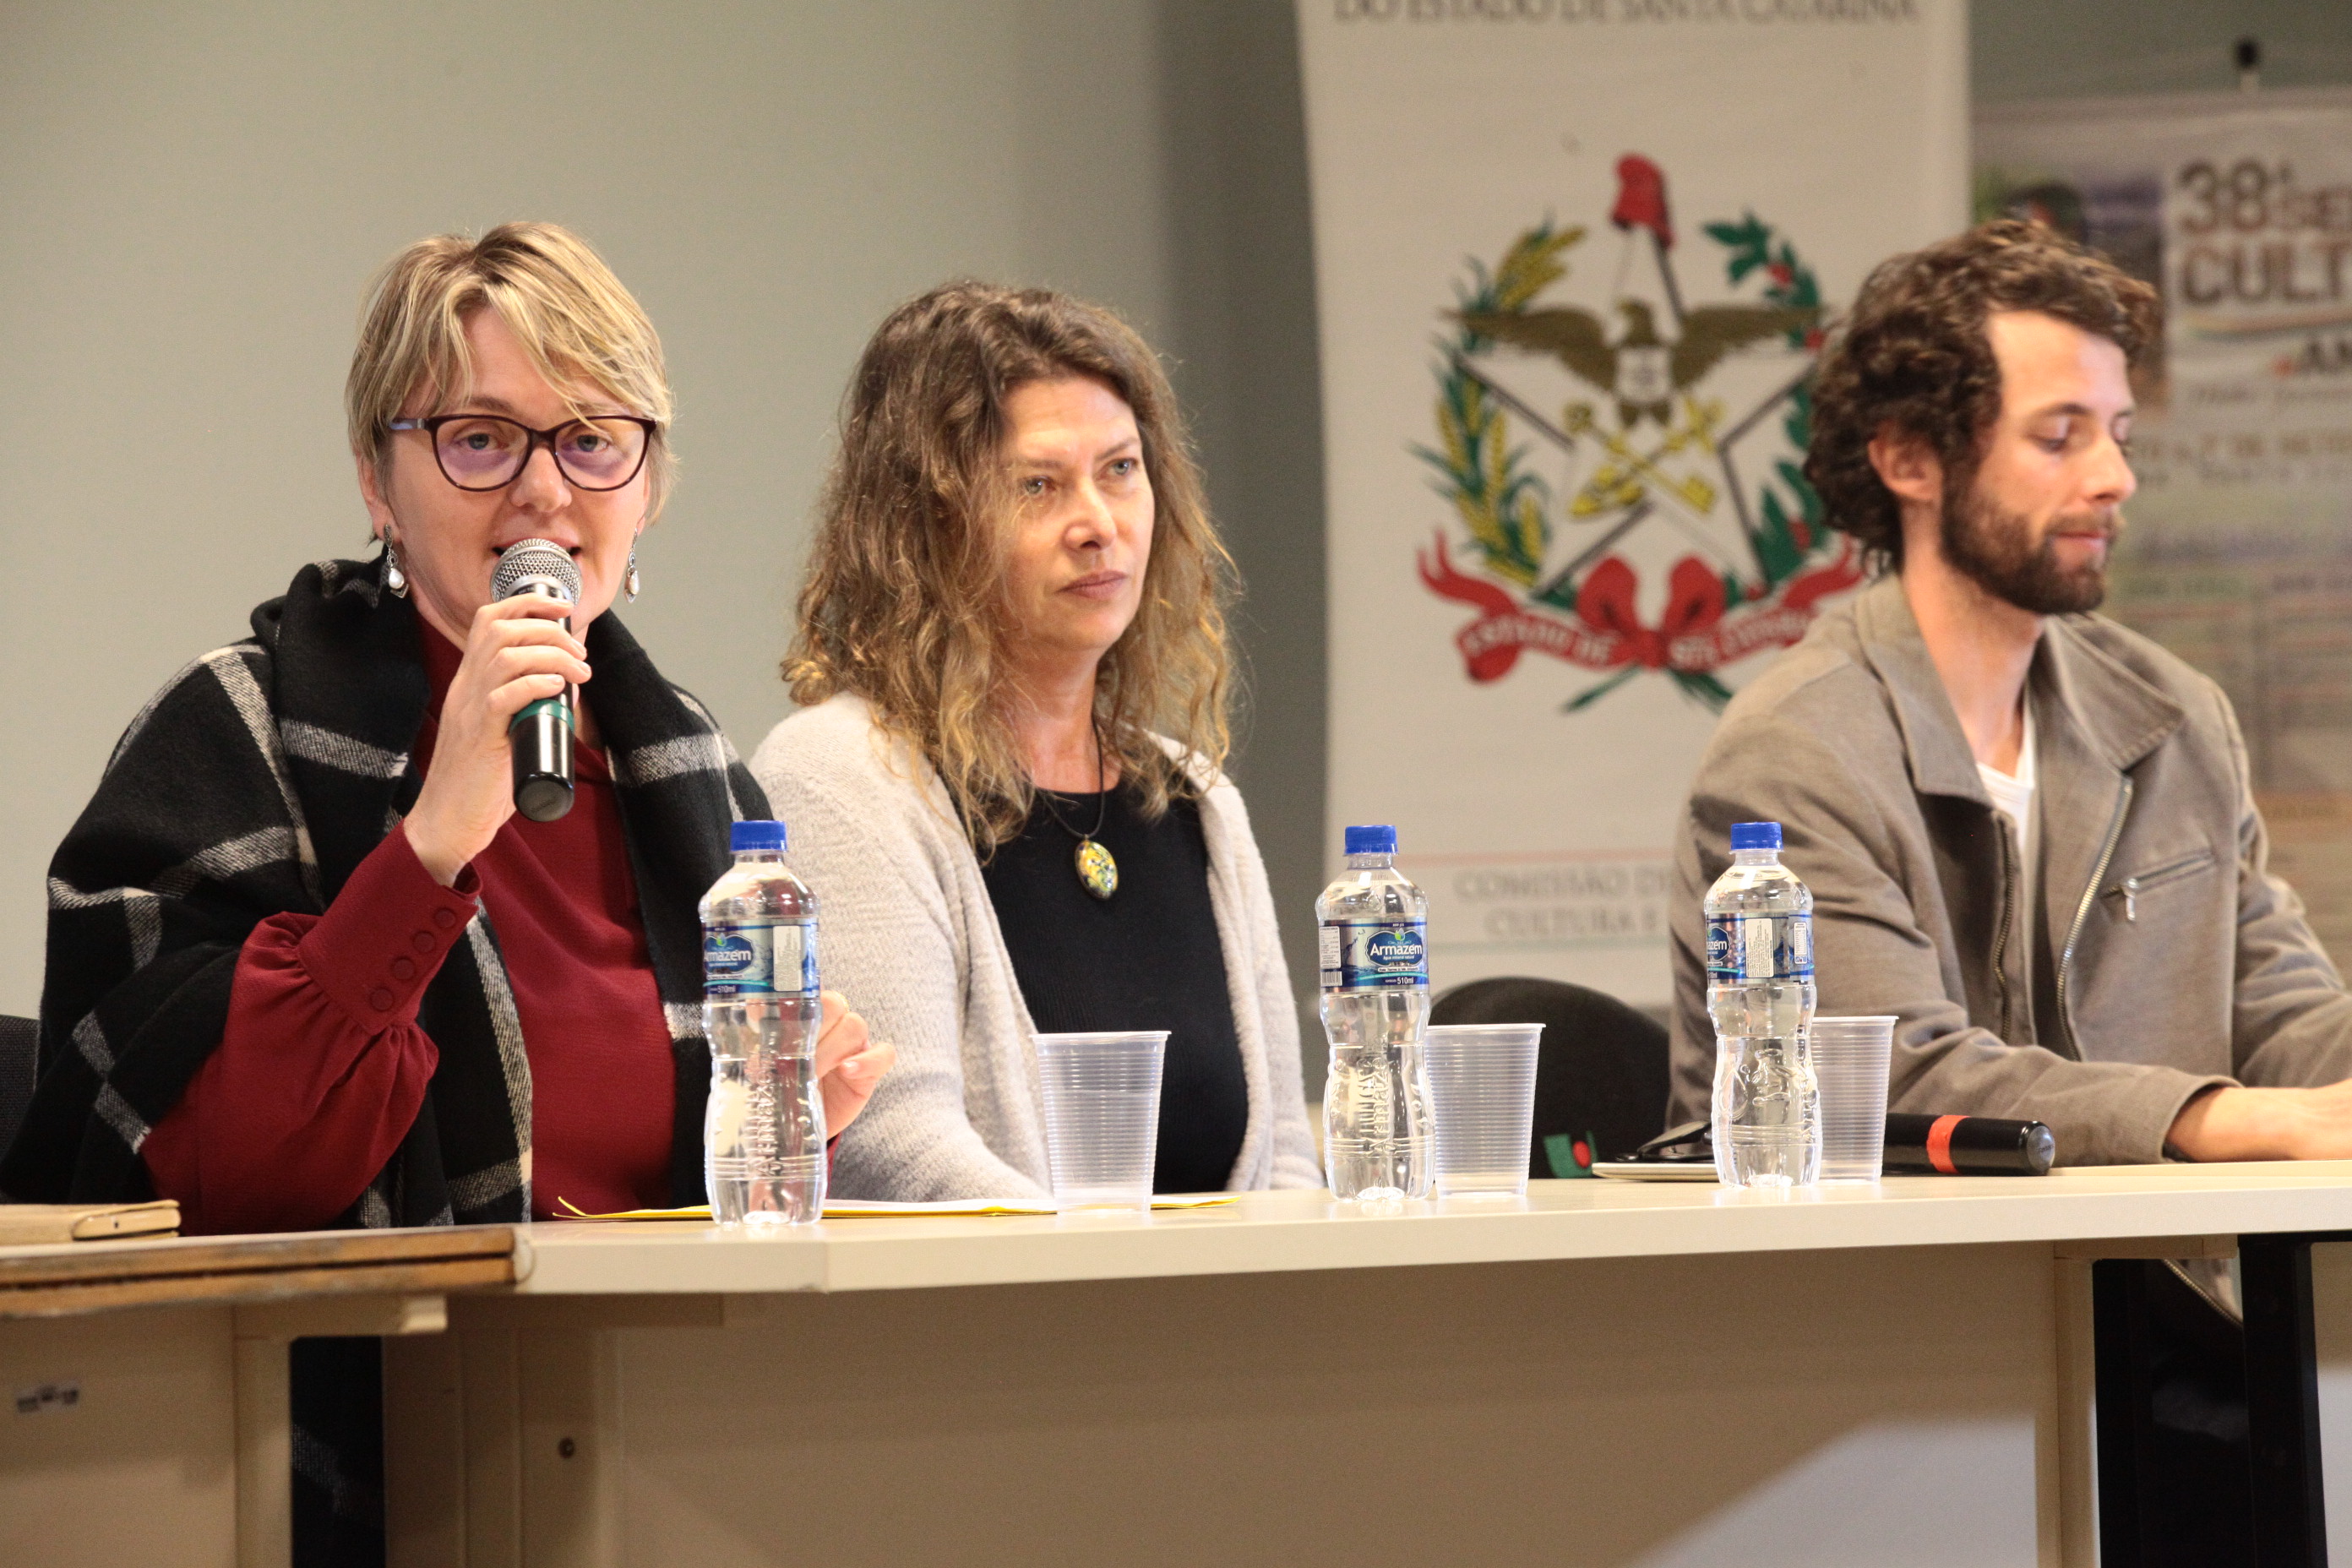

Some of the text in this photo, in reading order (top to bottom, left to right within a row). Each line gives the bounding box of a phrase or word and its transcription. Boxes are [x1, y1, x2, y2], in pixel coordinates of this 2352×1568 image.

[2182, 241, 2352, 304] CULT
[1370, 942, 1422, 956] Armazém
[1396, 977, 1414, 985] 510ml
